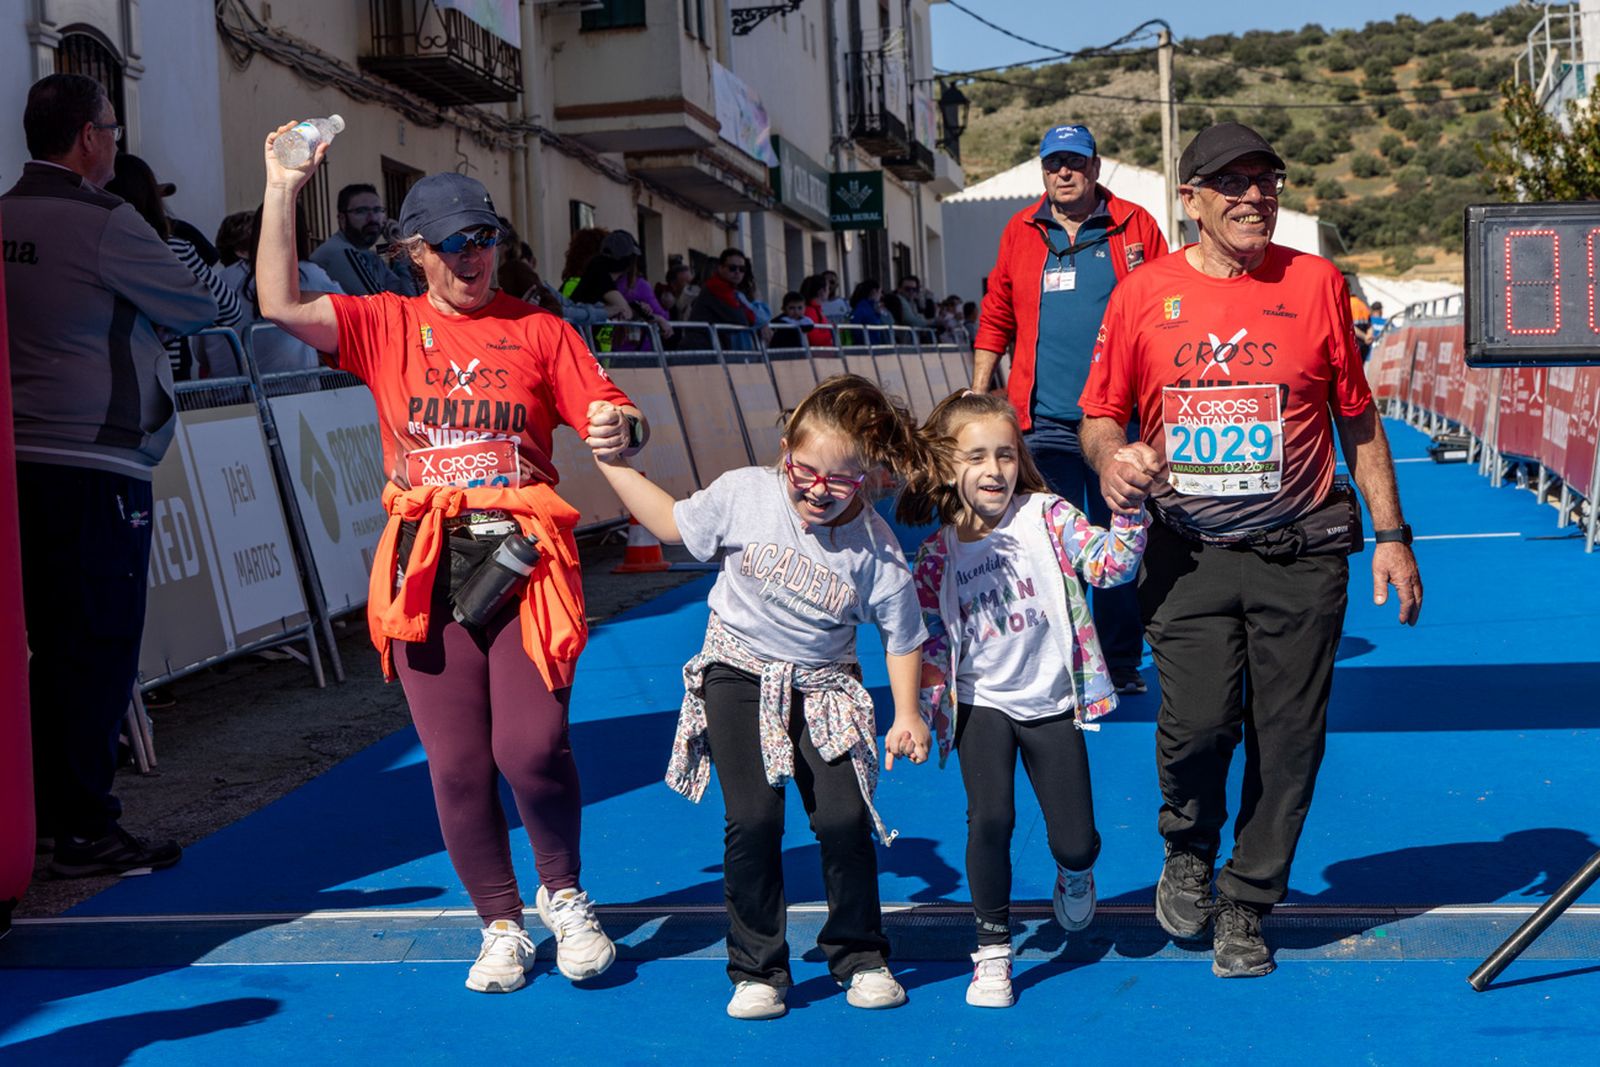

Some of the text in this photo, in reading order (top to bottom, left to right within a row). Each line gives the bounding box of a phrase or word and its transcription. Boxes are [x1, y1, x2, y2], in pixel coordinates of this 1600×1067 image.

[1174, 341, 1277, 368] CROSS
[425, 367, 509, 389] CROSS
[408, 396, 527, 433] PANTANO
[1177, 394, 1194, 415] X
[1196, 398, 1259, 416] CROSS
[1177, 414, 1246, 427] PANTANO
[1171, 423, 1274, 463] 2029
[420, 451, 499, 476] X CROSS
[1172, 463, 1206, 474] AMADOR
[221, 461, 257, 518] JAÉN
[421, 468, 487, 486] PANTANO
[234, 542, 282, 588] MARTOS
